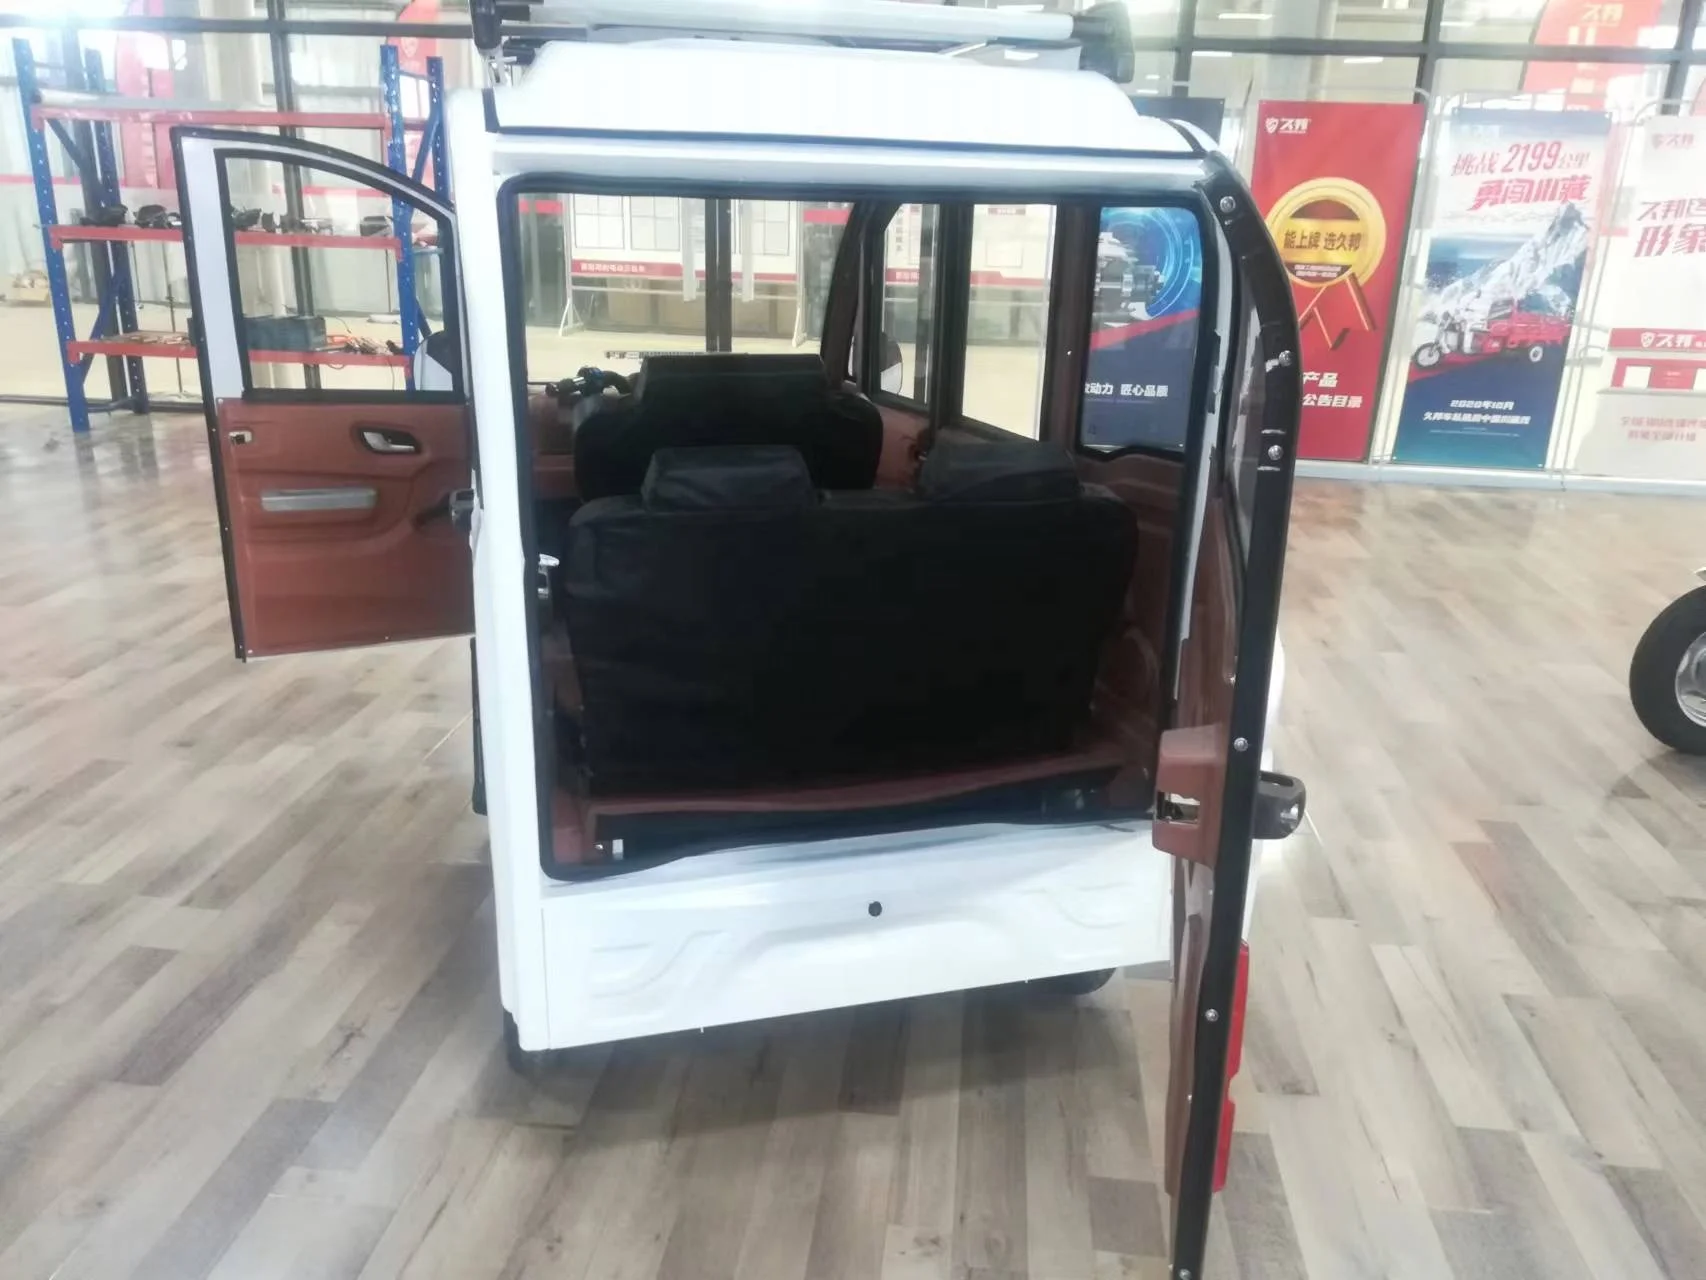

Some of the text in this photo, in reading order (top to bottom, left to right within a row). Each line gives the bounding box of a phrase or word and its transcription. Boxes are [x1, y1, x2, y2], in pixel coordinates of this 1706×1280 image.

[1467, 174, 1592, 211] 勇闯川藏
[1303, 371, 1338, 387] 产品
[1120, 383, 1168, 397] 匠心品质
[1302, 393, 1363, 408] 公告目录
